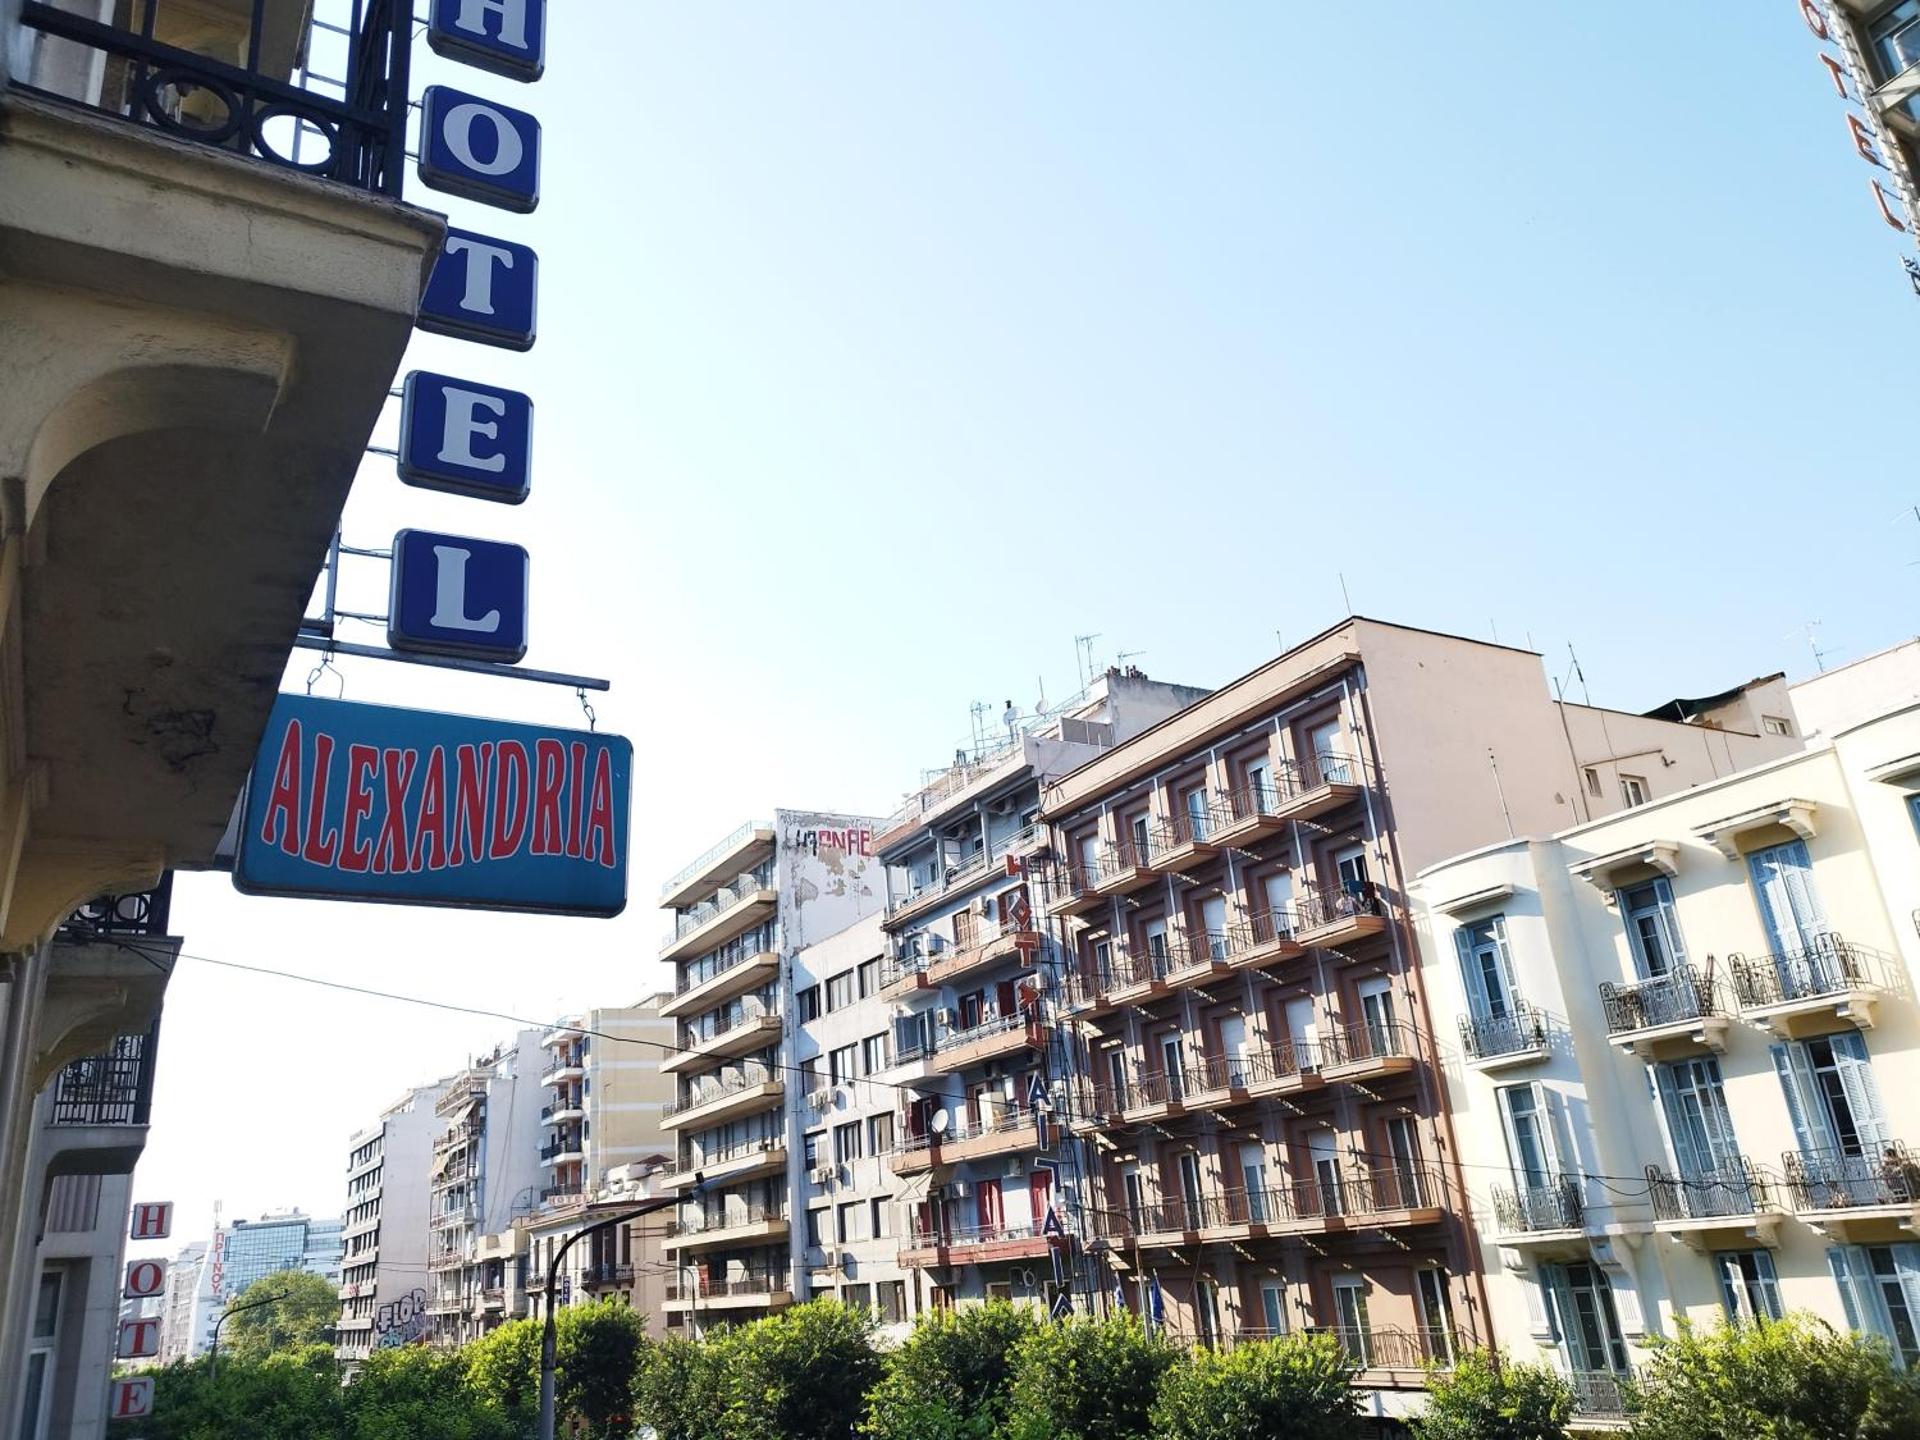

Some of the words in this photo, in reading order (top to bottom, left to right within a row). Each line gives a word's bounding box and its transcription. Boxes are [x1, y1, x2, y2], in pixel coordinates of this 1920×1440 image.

[430, 0, 528, 632] HOTEL
[261, 718, 617, 875] ALEXANDRIA
[114, 1204, 169, 1417] HOTE
